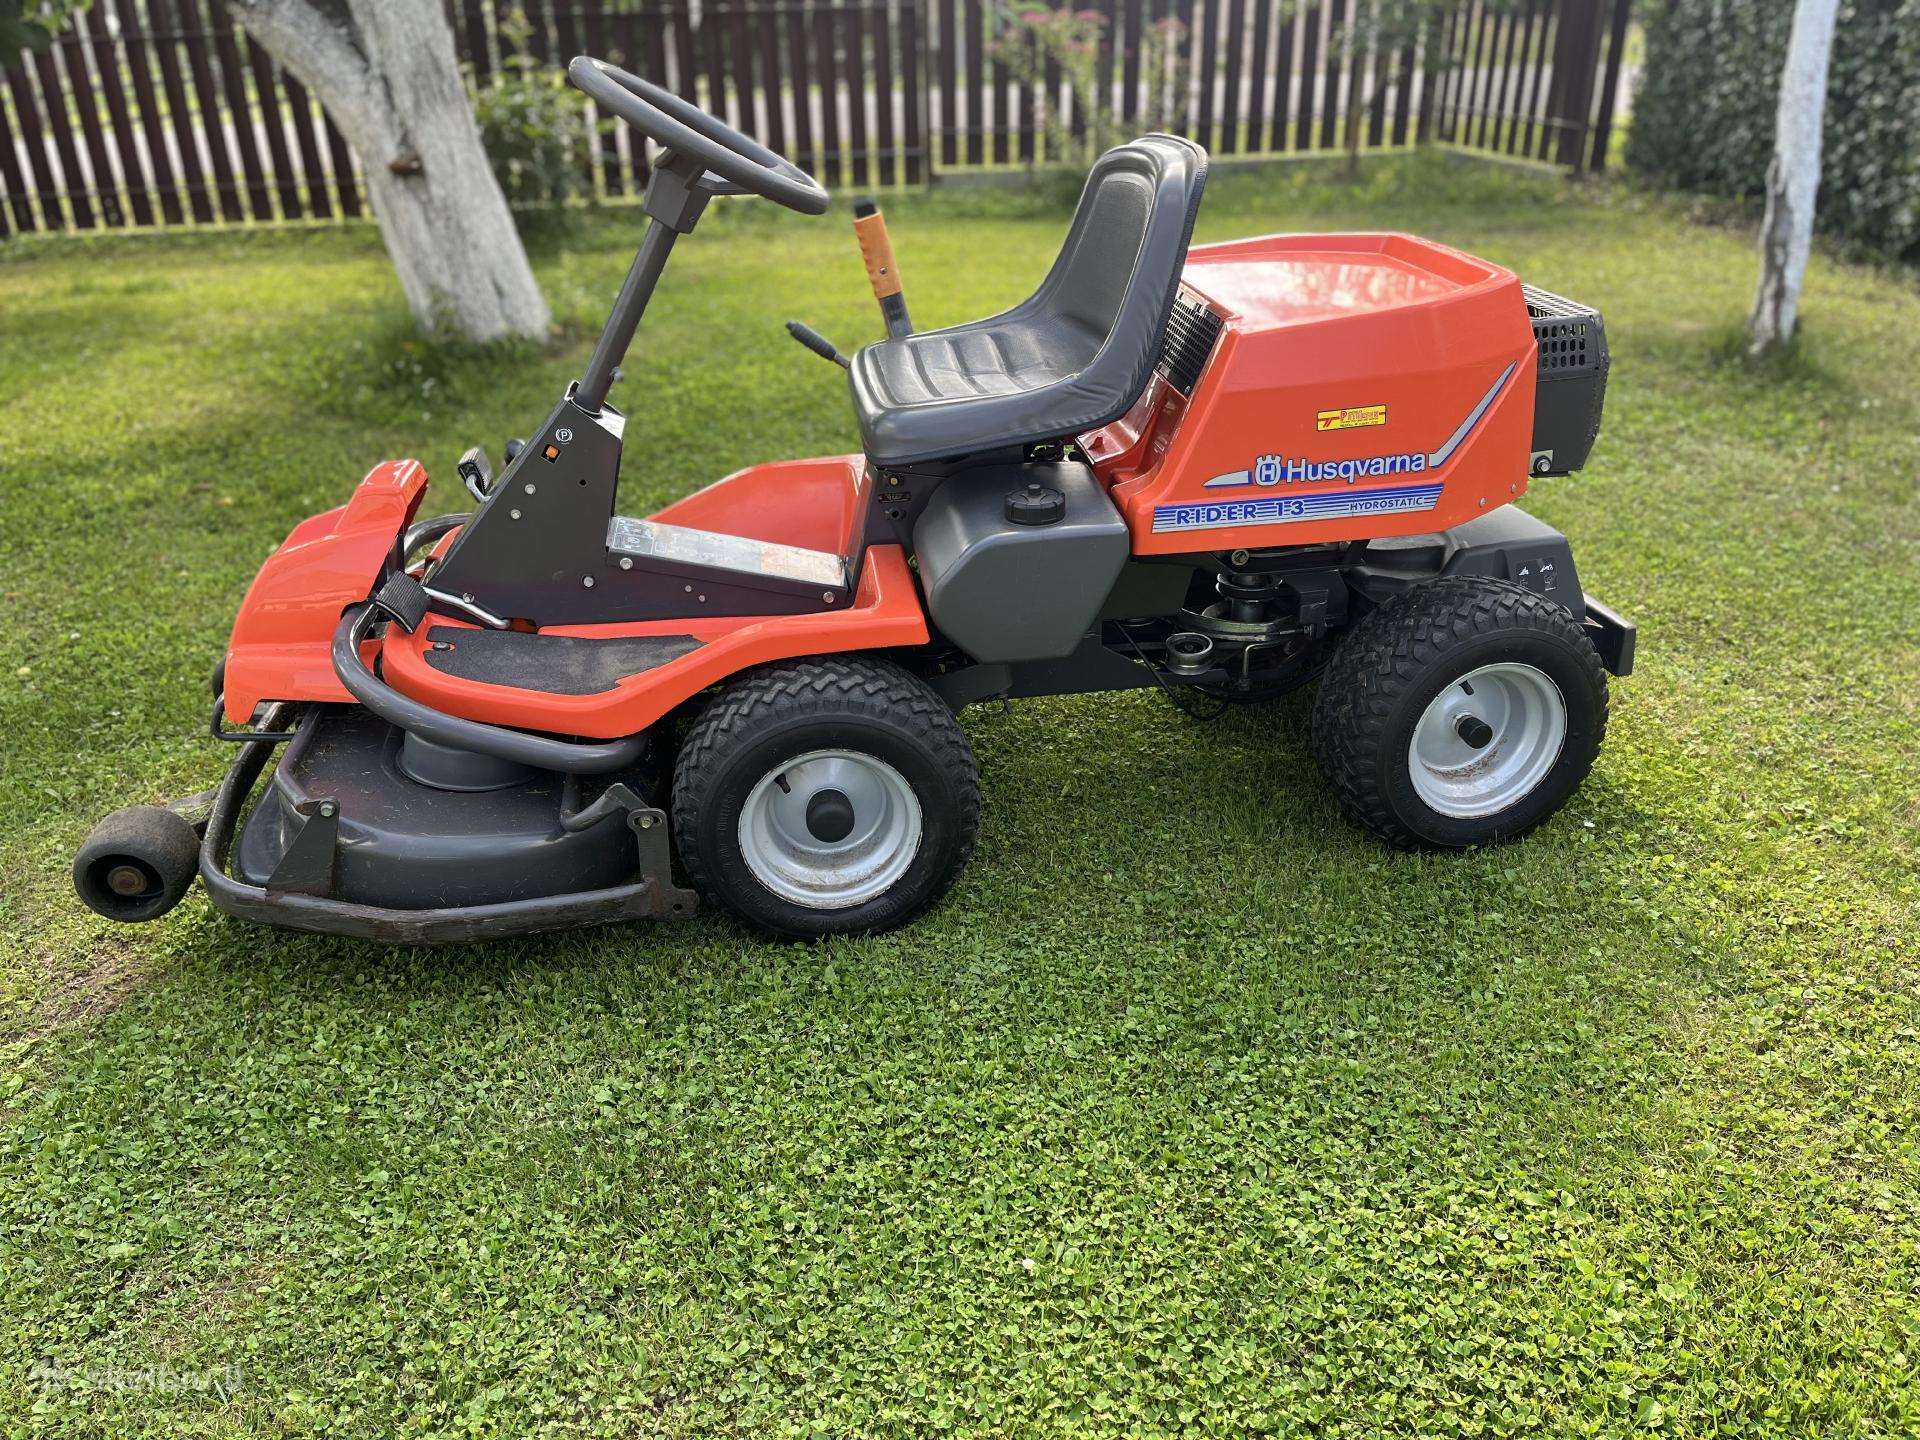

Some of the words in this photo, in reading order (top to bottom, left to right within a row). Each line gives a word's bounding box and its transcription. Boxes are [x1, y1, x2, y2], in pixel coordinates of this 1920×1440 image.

[1286, 452, 1426, 484] Husqvarna
[1176, 504, 1257, 525] RIDER
[1275, 500, 1305, 517] 13
[1350, 496, 1423, 511] HYDROSTATIC
